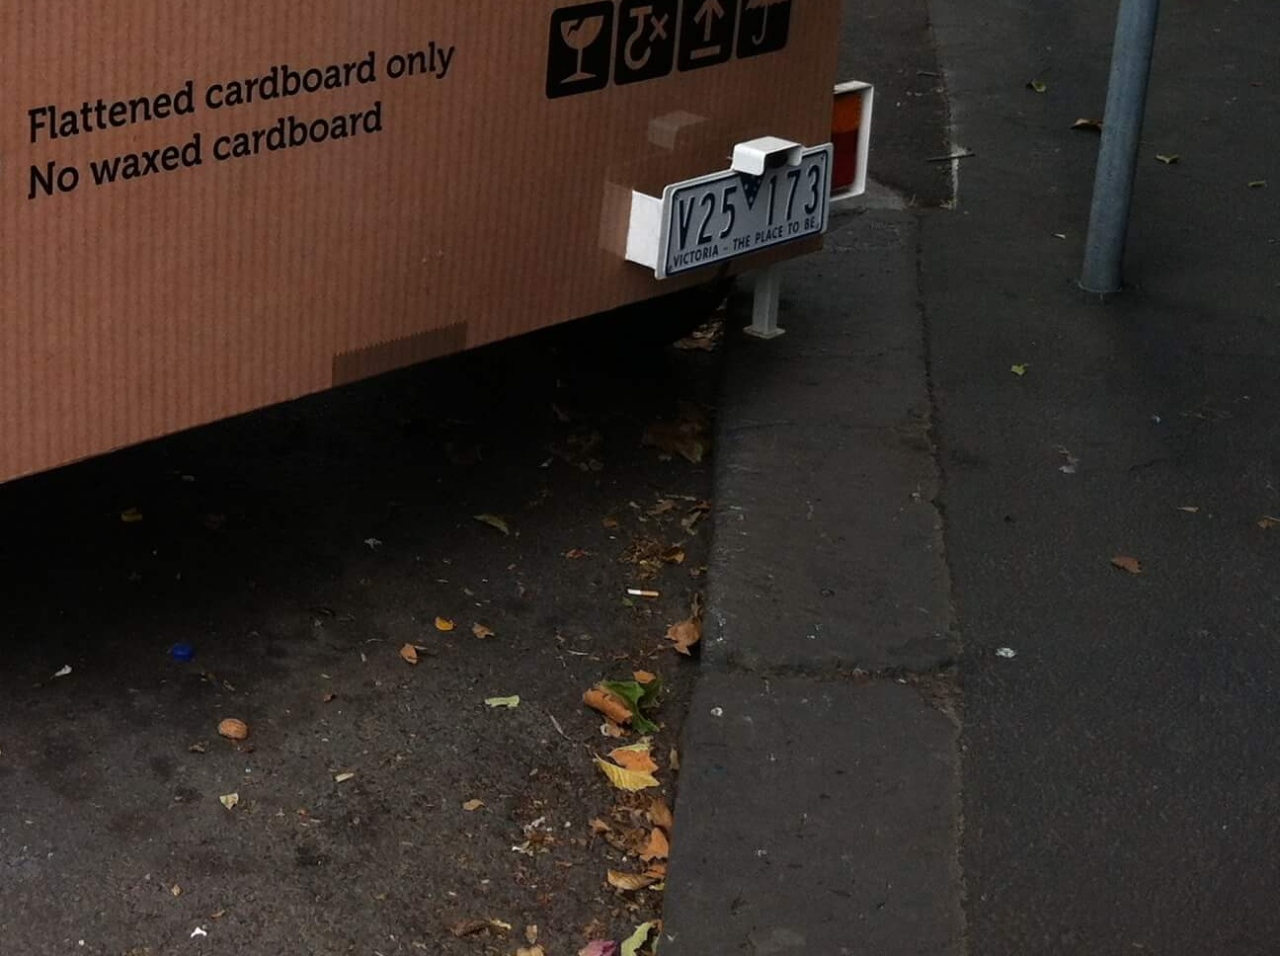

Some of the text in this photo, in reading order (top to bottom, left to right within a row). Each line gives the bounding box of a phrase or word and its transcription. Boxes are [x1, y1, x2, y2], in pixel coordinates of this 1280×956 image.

[28, 41, 456, 143] Flattened cardboard only
[28, 100, 383, 200] No waxed cardboard
[673, 246, 719, 268] VICTORIA
[733, 236, 751, 249] THE
[755, 226, 783, 244] PLACE
[788, 221, 799, 234] TO
[804, 216, 816, 230] BE
[678, 165, 821, 250] V25 173
